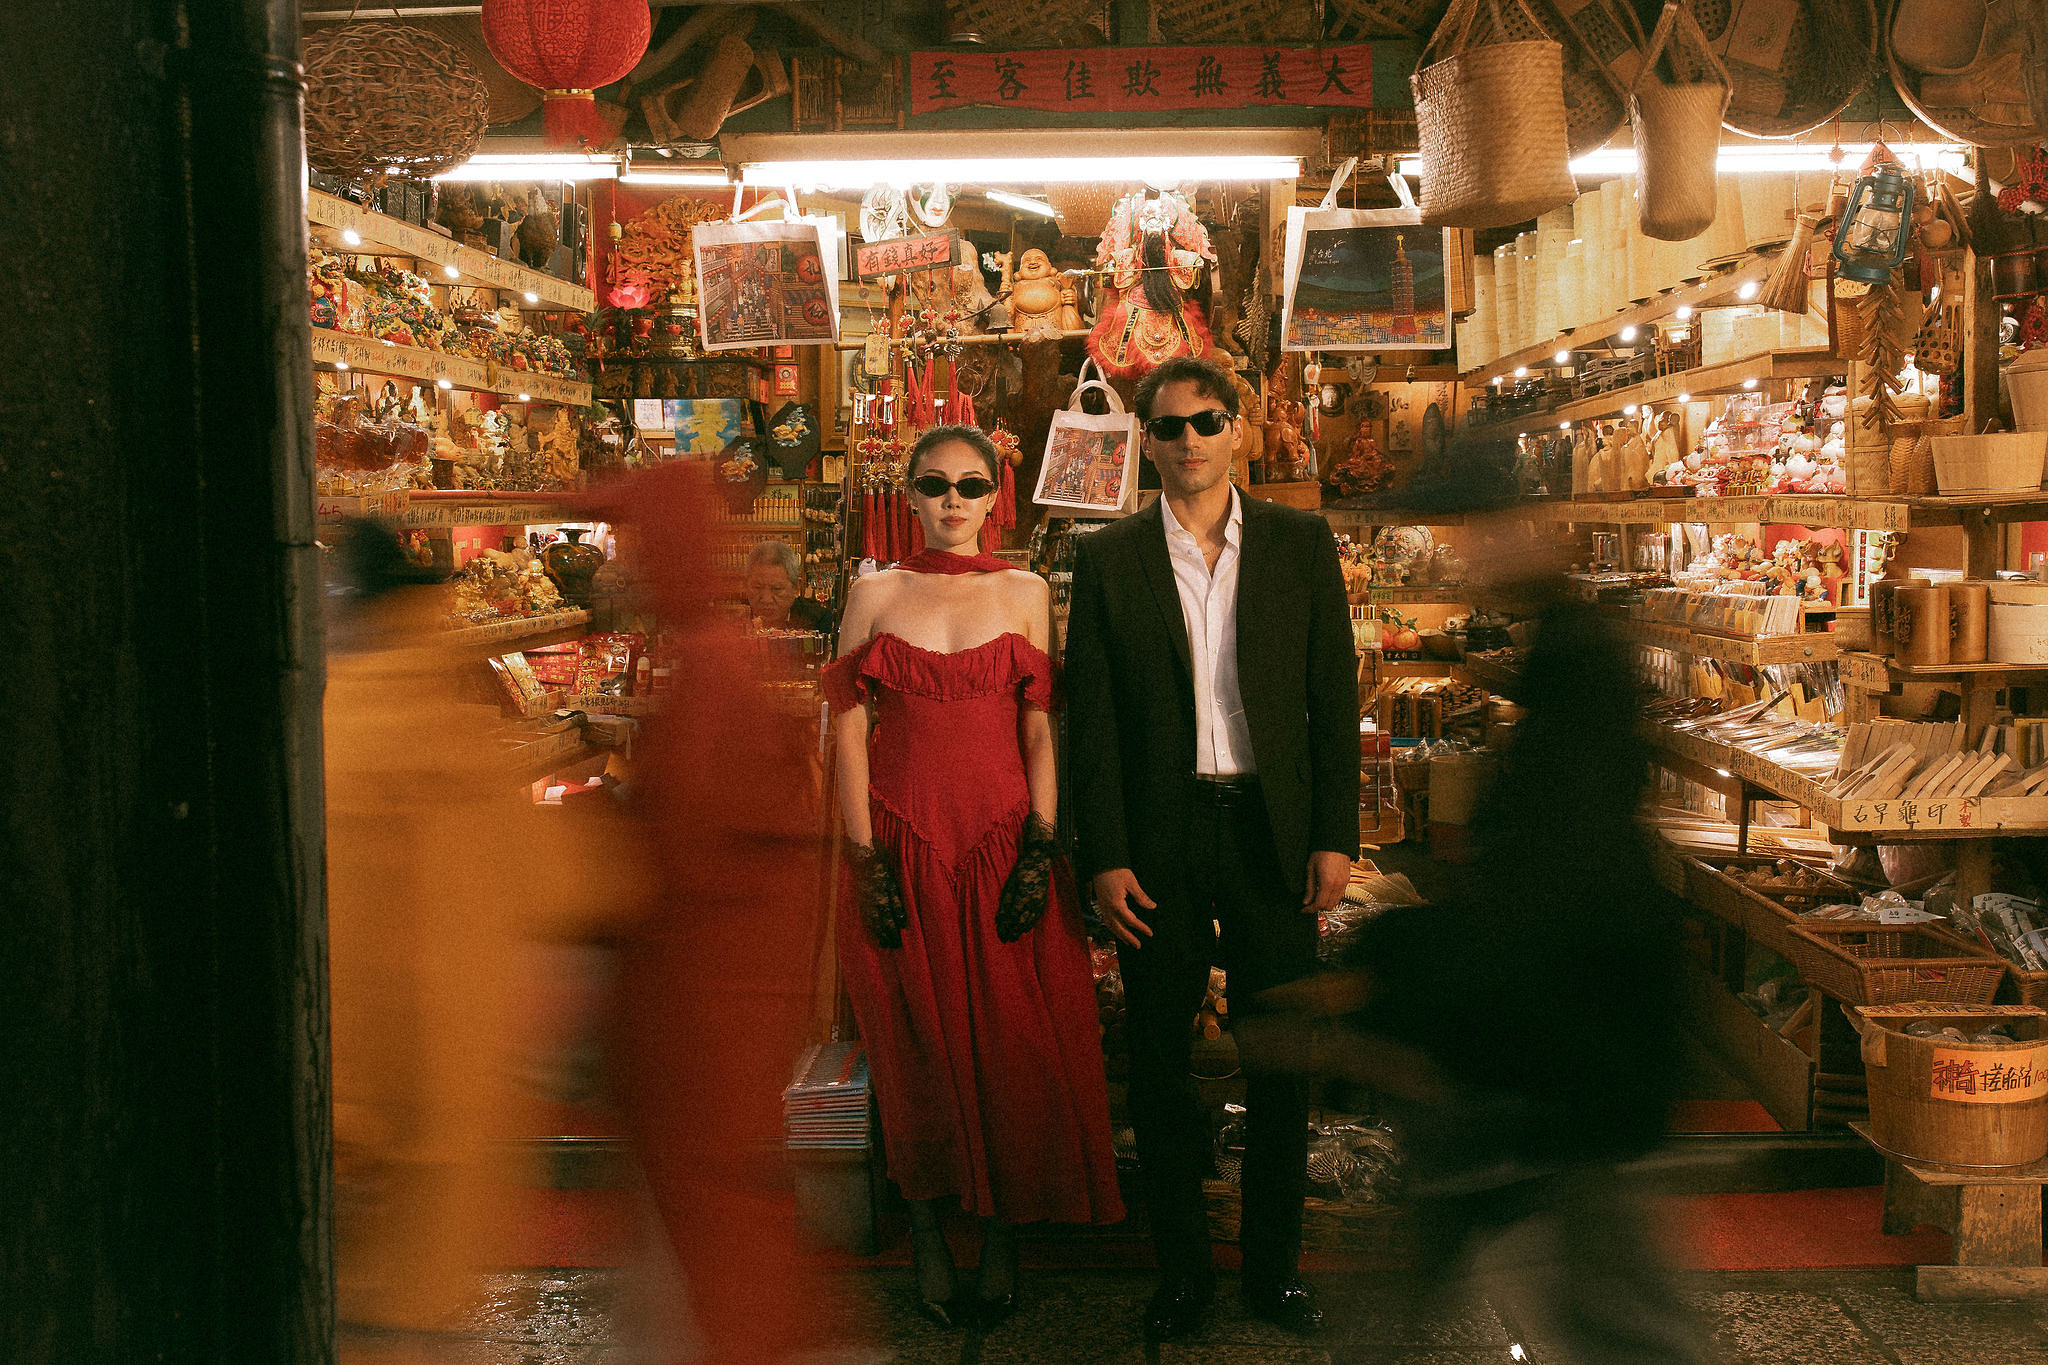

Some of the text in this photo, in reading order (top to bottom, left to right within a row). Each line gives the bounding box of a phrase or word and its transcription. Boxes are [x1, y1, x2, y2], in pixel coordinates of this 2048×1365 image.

[865, 241, 938, 271] 有錢真好
[1852, 799, 1948, 829] 古早龜印
